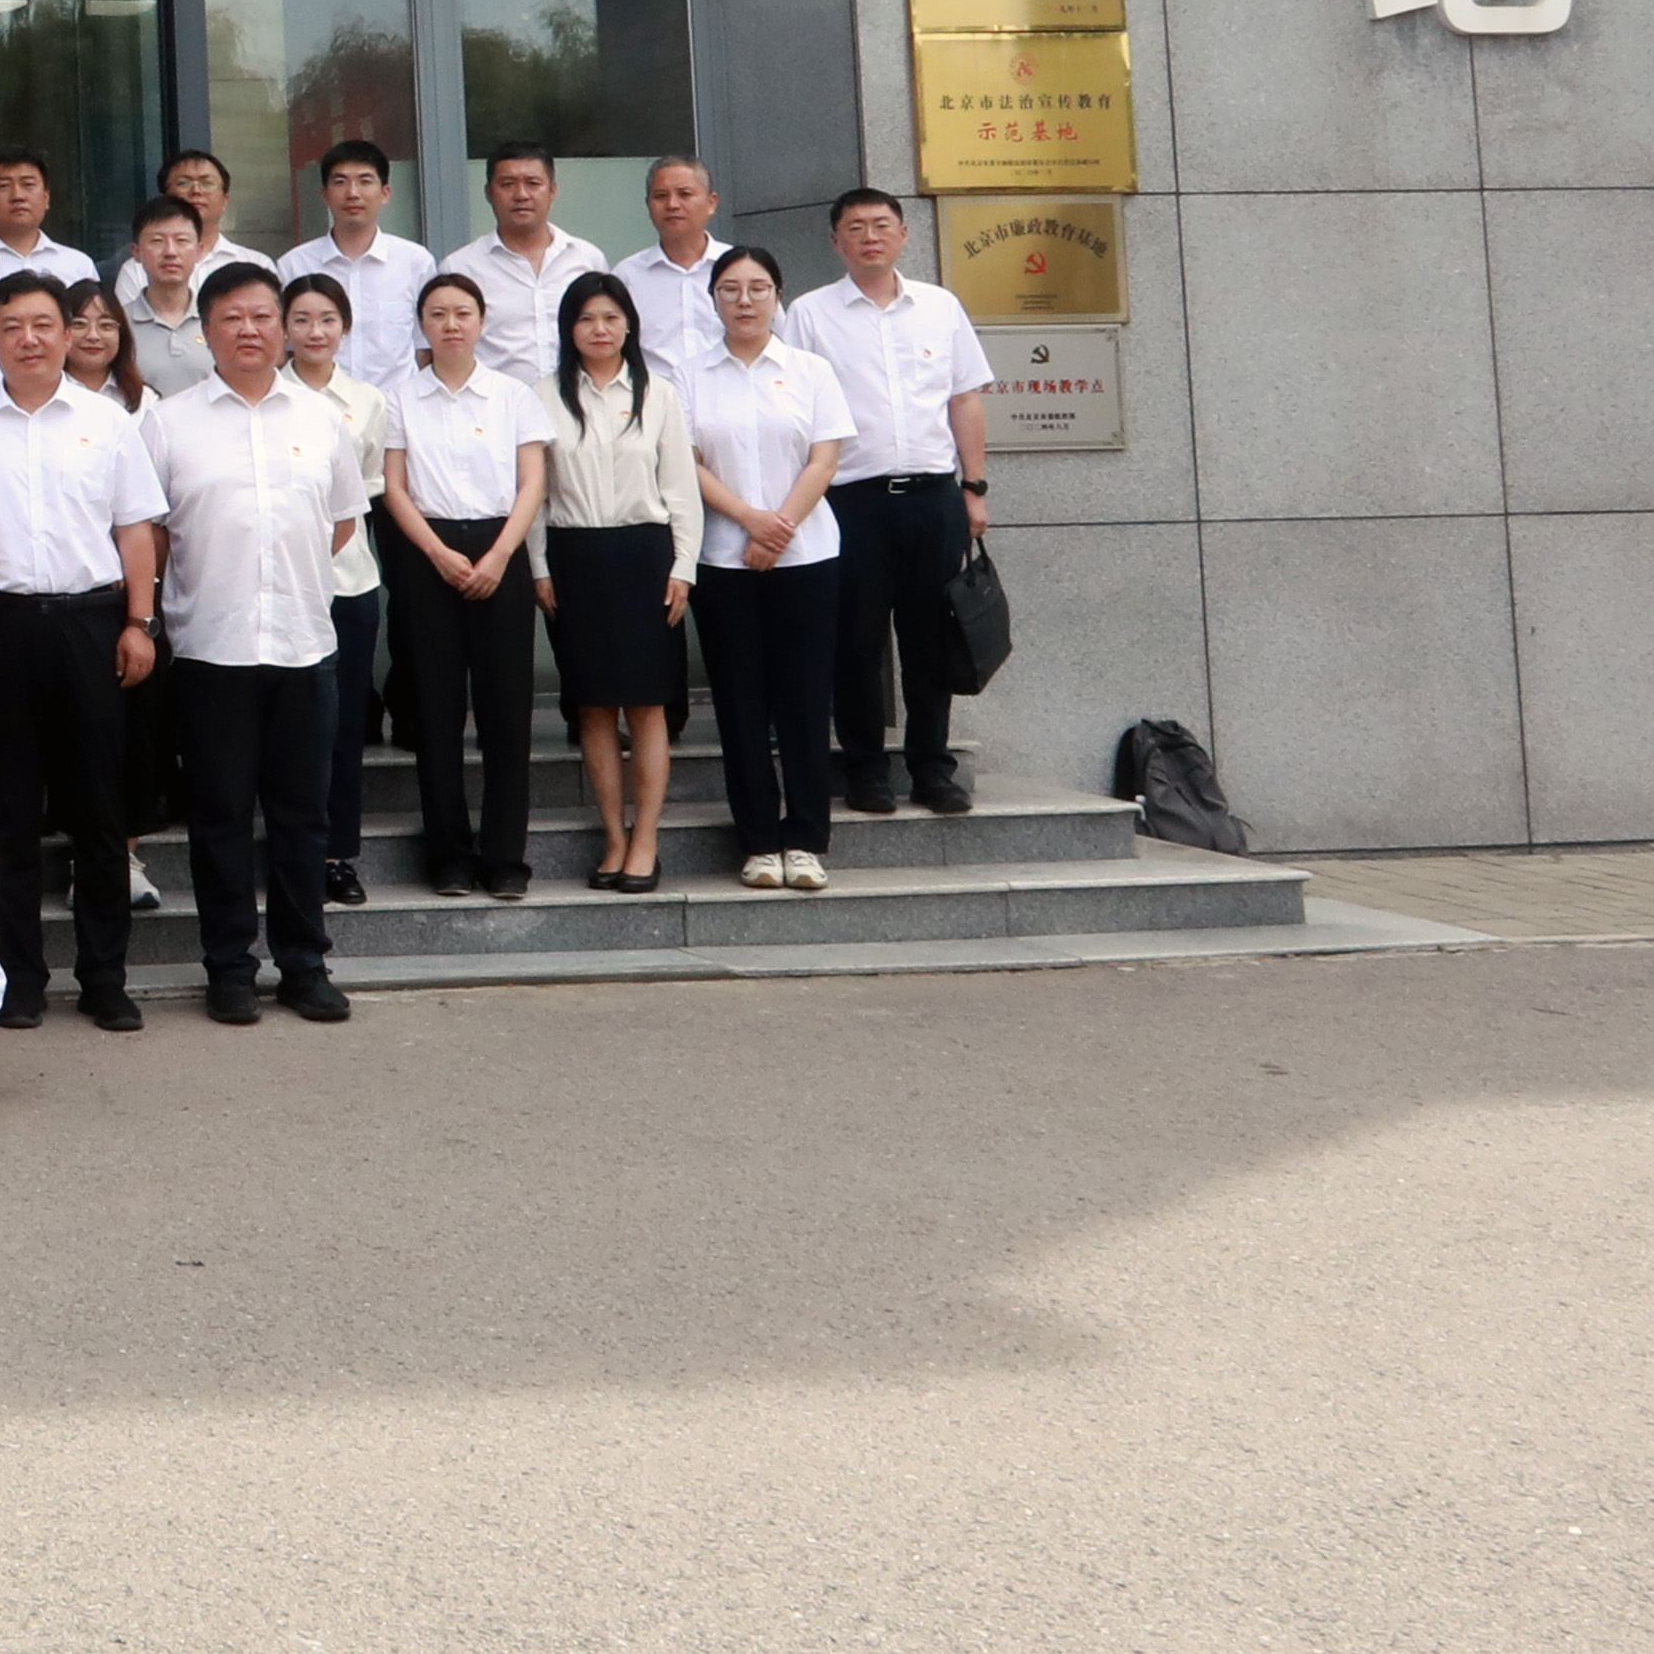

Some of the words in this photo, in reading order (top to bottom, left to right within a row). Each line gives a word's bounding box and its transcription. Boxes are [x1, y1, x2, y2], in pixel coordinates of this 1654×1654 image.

[939, 94, 1112, 111] 北京市法治宣传教育
[978, 120, 1079, 143] 示范基地
[963, 218, 1109, 260] 北京市廉政教育基地
